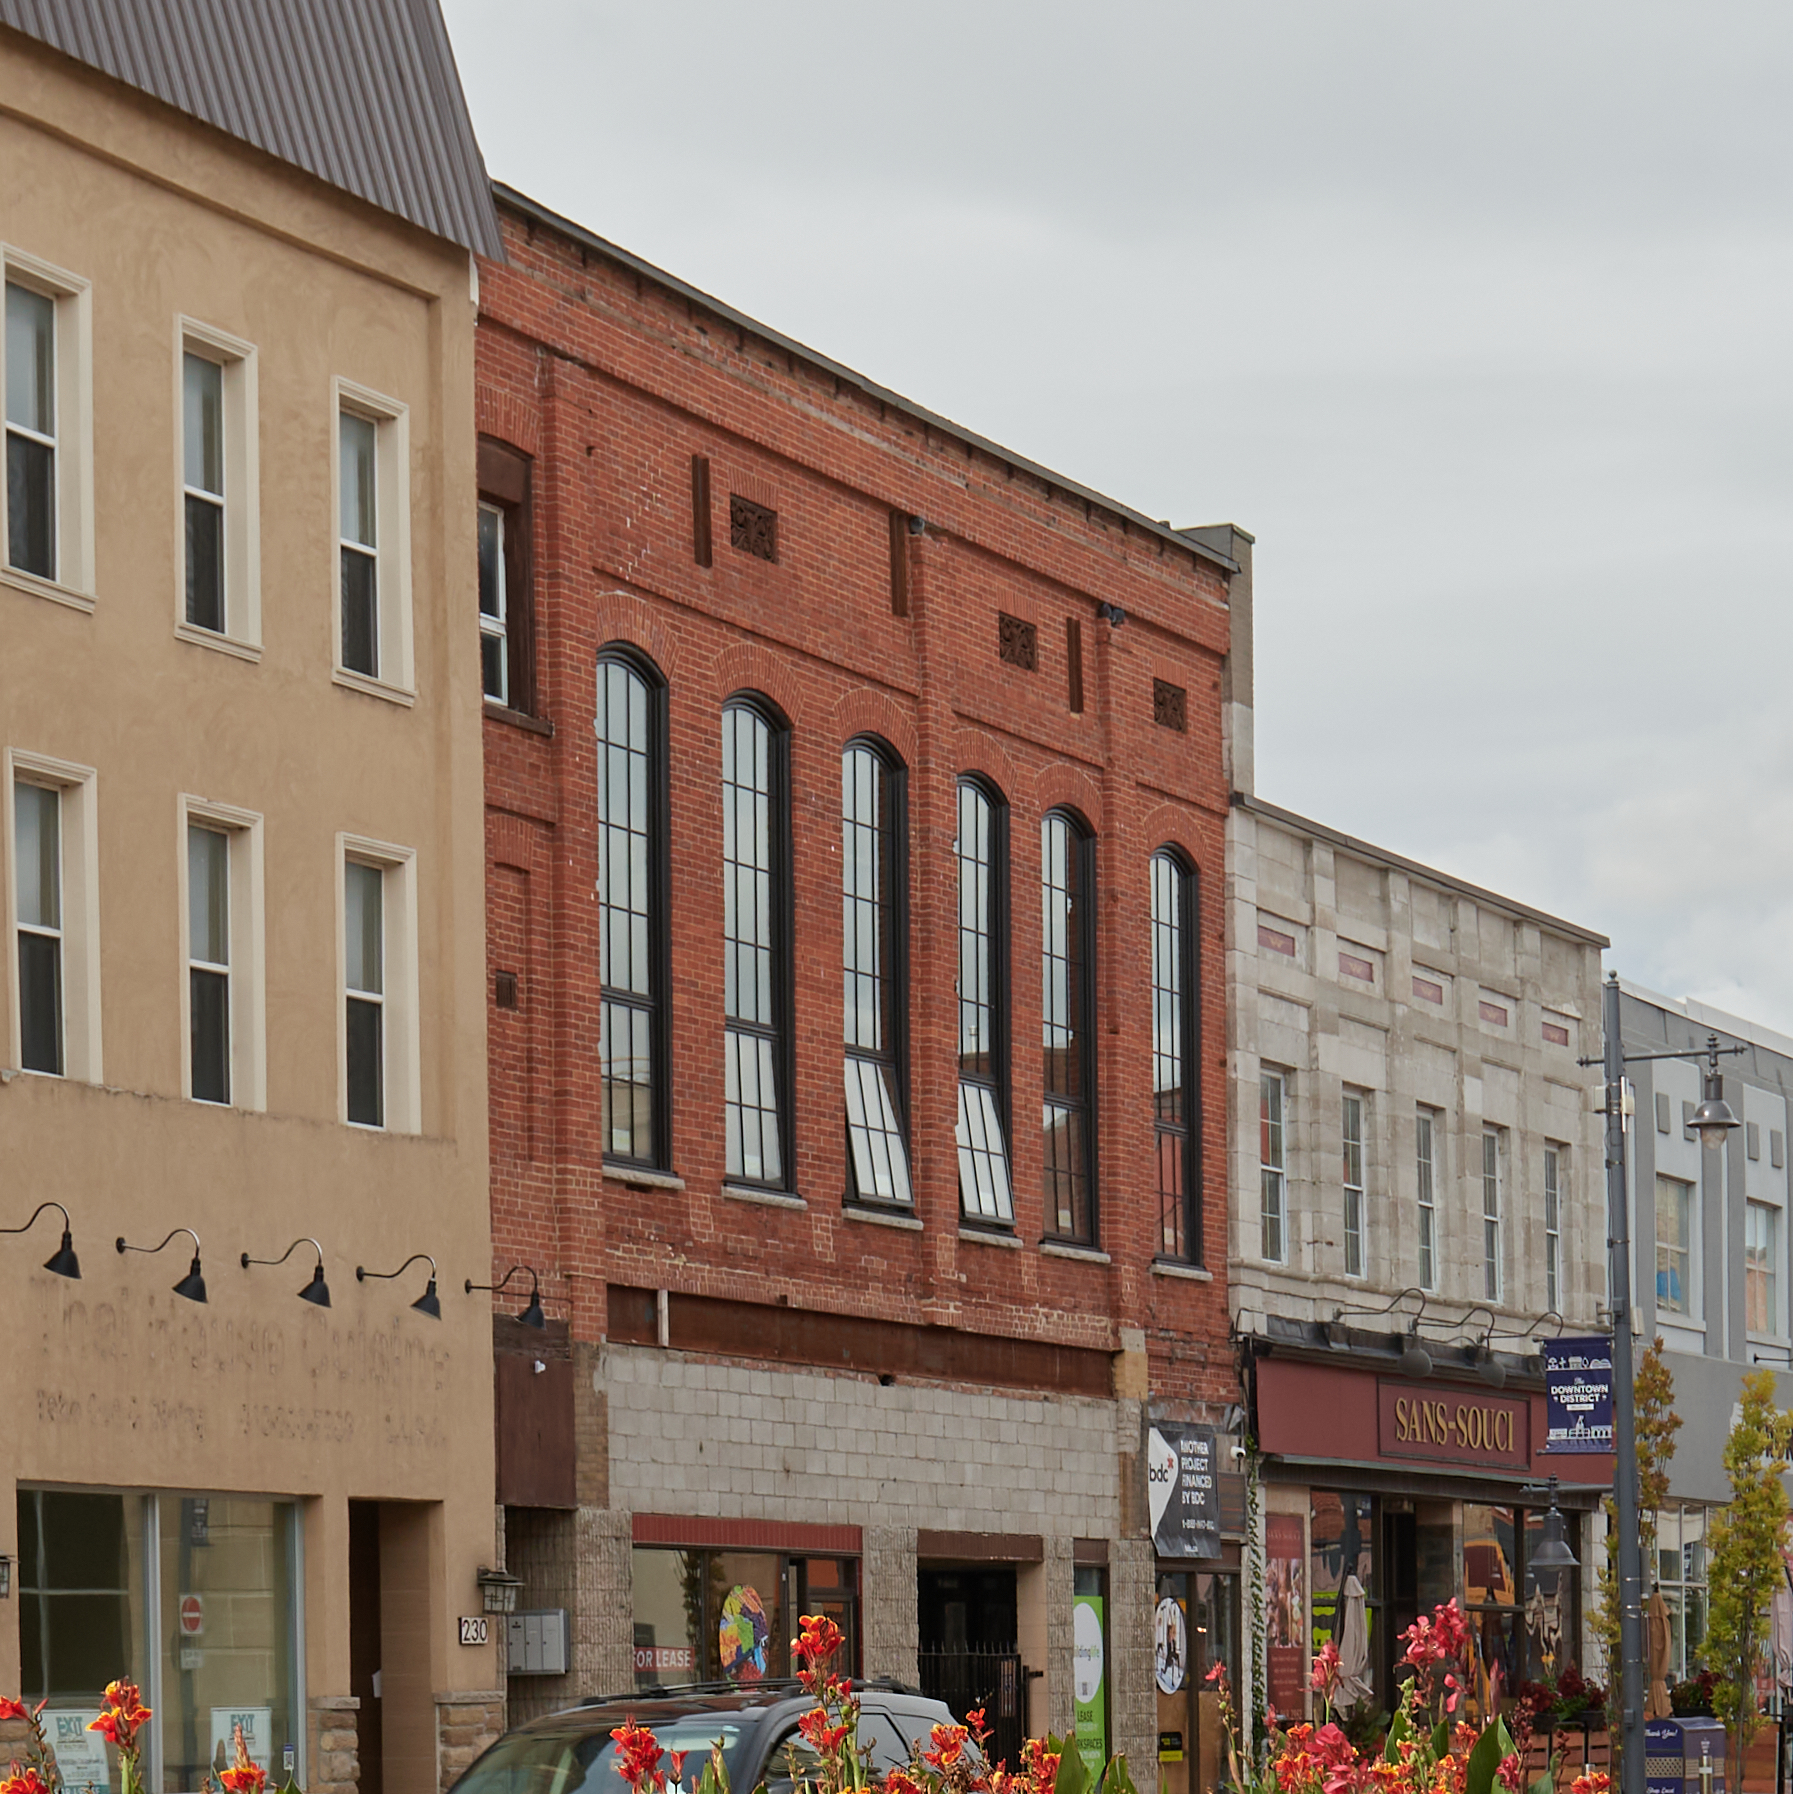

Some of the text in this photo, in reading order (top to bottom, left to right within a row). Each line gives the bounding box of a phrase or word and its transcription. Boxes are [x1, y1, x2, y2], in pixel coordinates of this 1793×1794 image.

[1550, 1384, 1609, 1396] DOWNTOWN
[1560, 1393, 1600, 1404] DISTRICT
[1395, 1397, 1514, 1452] SANS-SOUCI
[1149, 1463, 1169, 1482] bdc
[462, 1619, 488, 1642] 230
[656, 1650, 692, 1668] LEASE
[55, 1716, 83, 1737] EXIT
